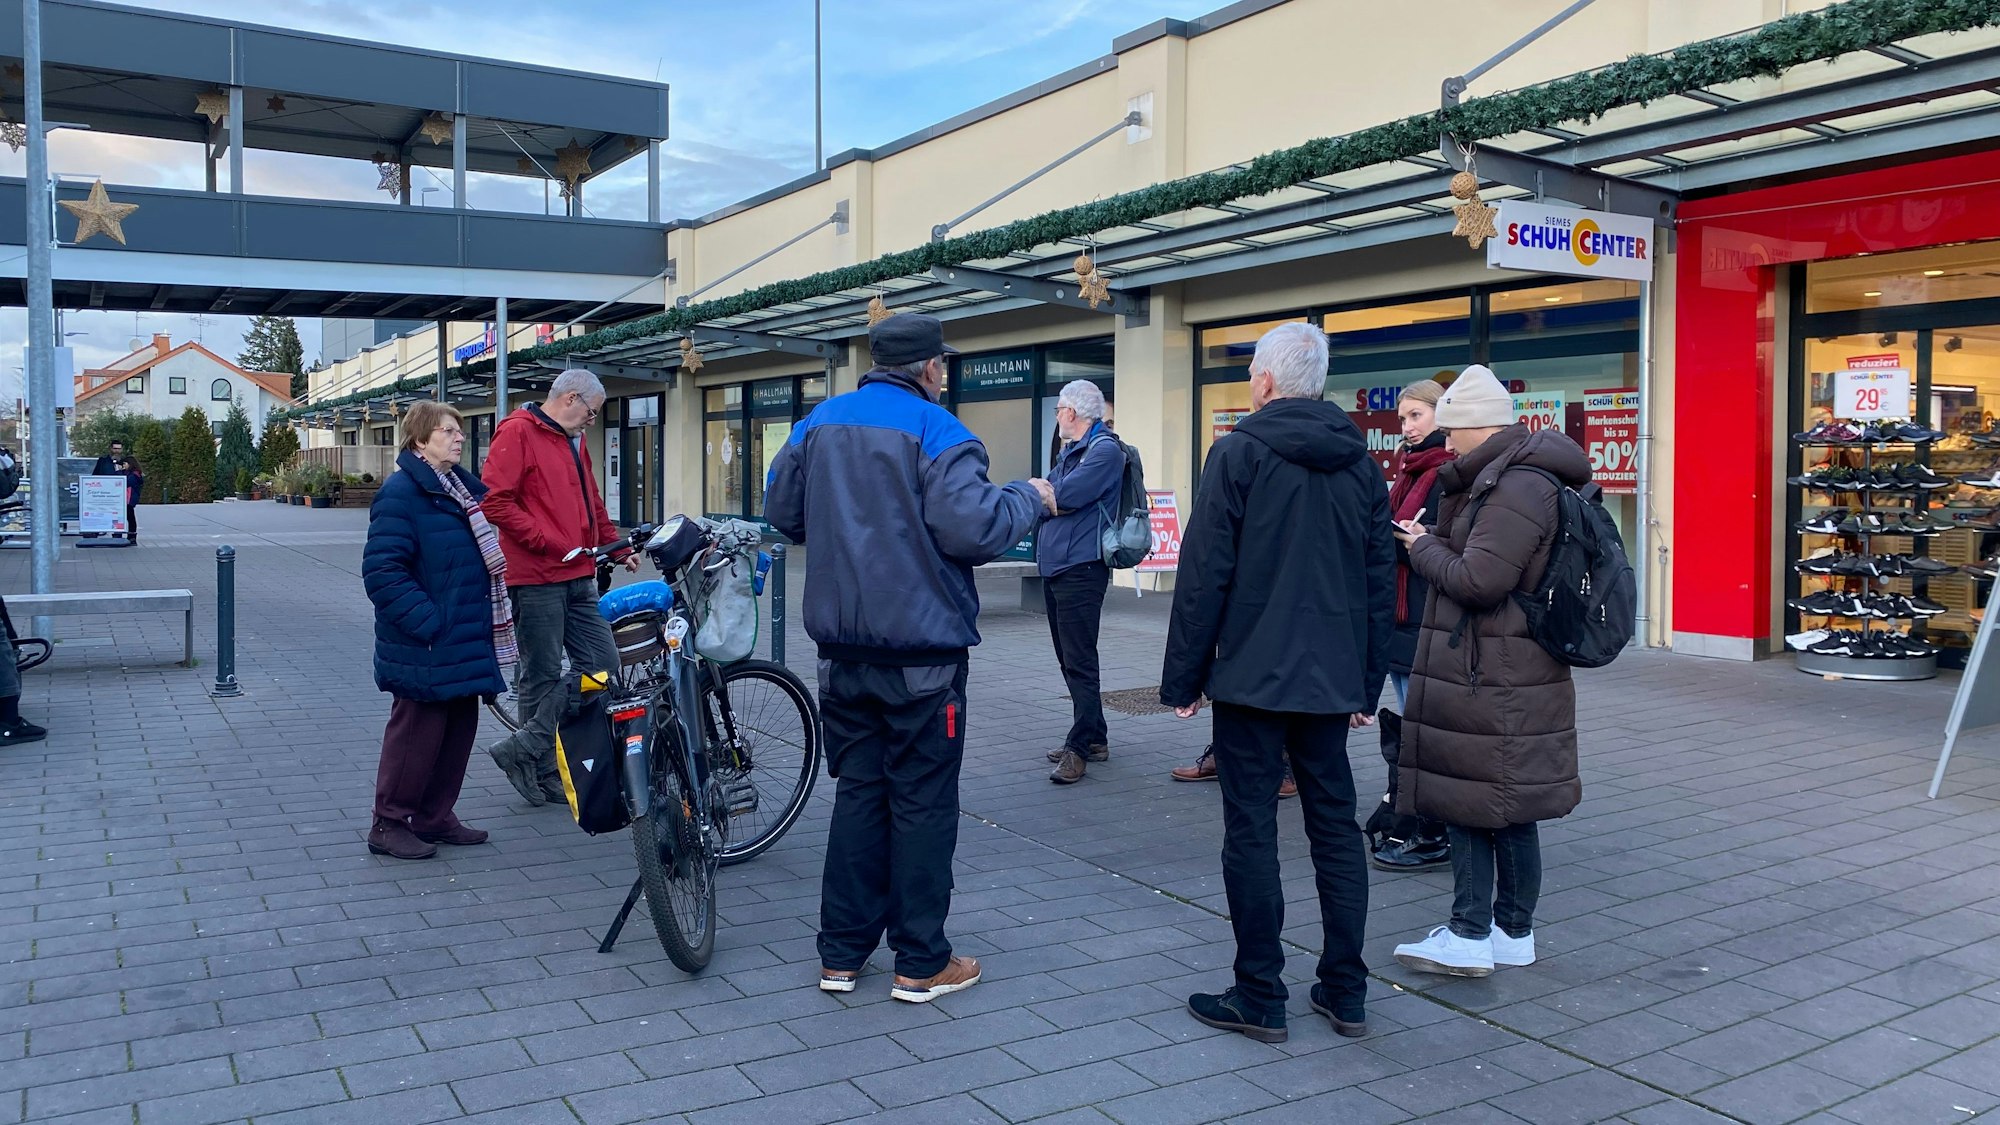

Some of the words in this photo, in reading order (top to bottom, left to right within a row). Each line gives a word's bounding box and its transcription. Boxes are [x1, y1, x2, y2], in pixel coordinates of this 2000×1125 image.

[1545, 216, 1571, 228] SIEMES
[1507, 222, 1571, 251] SCHUH
[1579, 229, 1647, 260] CENTER
[974, 358, 1030, 376] HALLMANN
[1850, 359, 1898, 368] reduziert
[759, 386, 793, 398] HALLMANN
[1513, 398, 1561, 410] indertage
[1588, 398, 1612, 406] SCHUH
[1855, 388, 1879, 411] 29
[1604, 428, 1616, 437] bis
[1588, 441, 1638, 471] 50%
[1151, 530, 1180, 552] 0%
